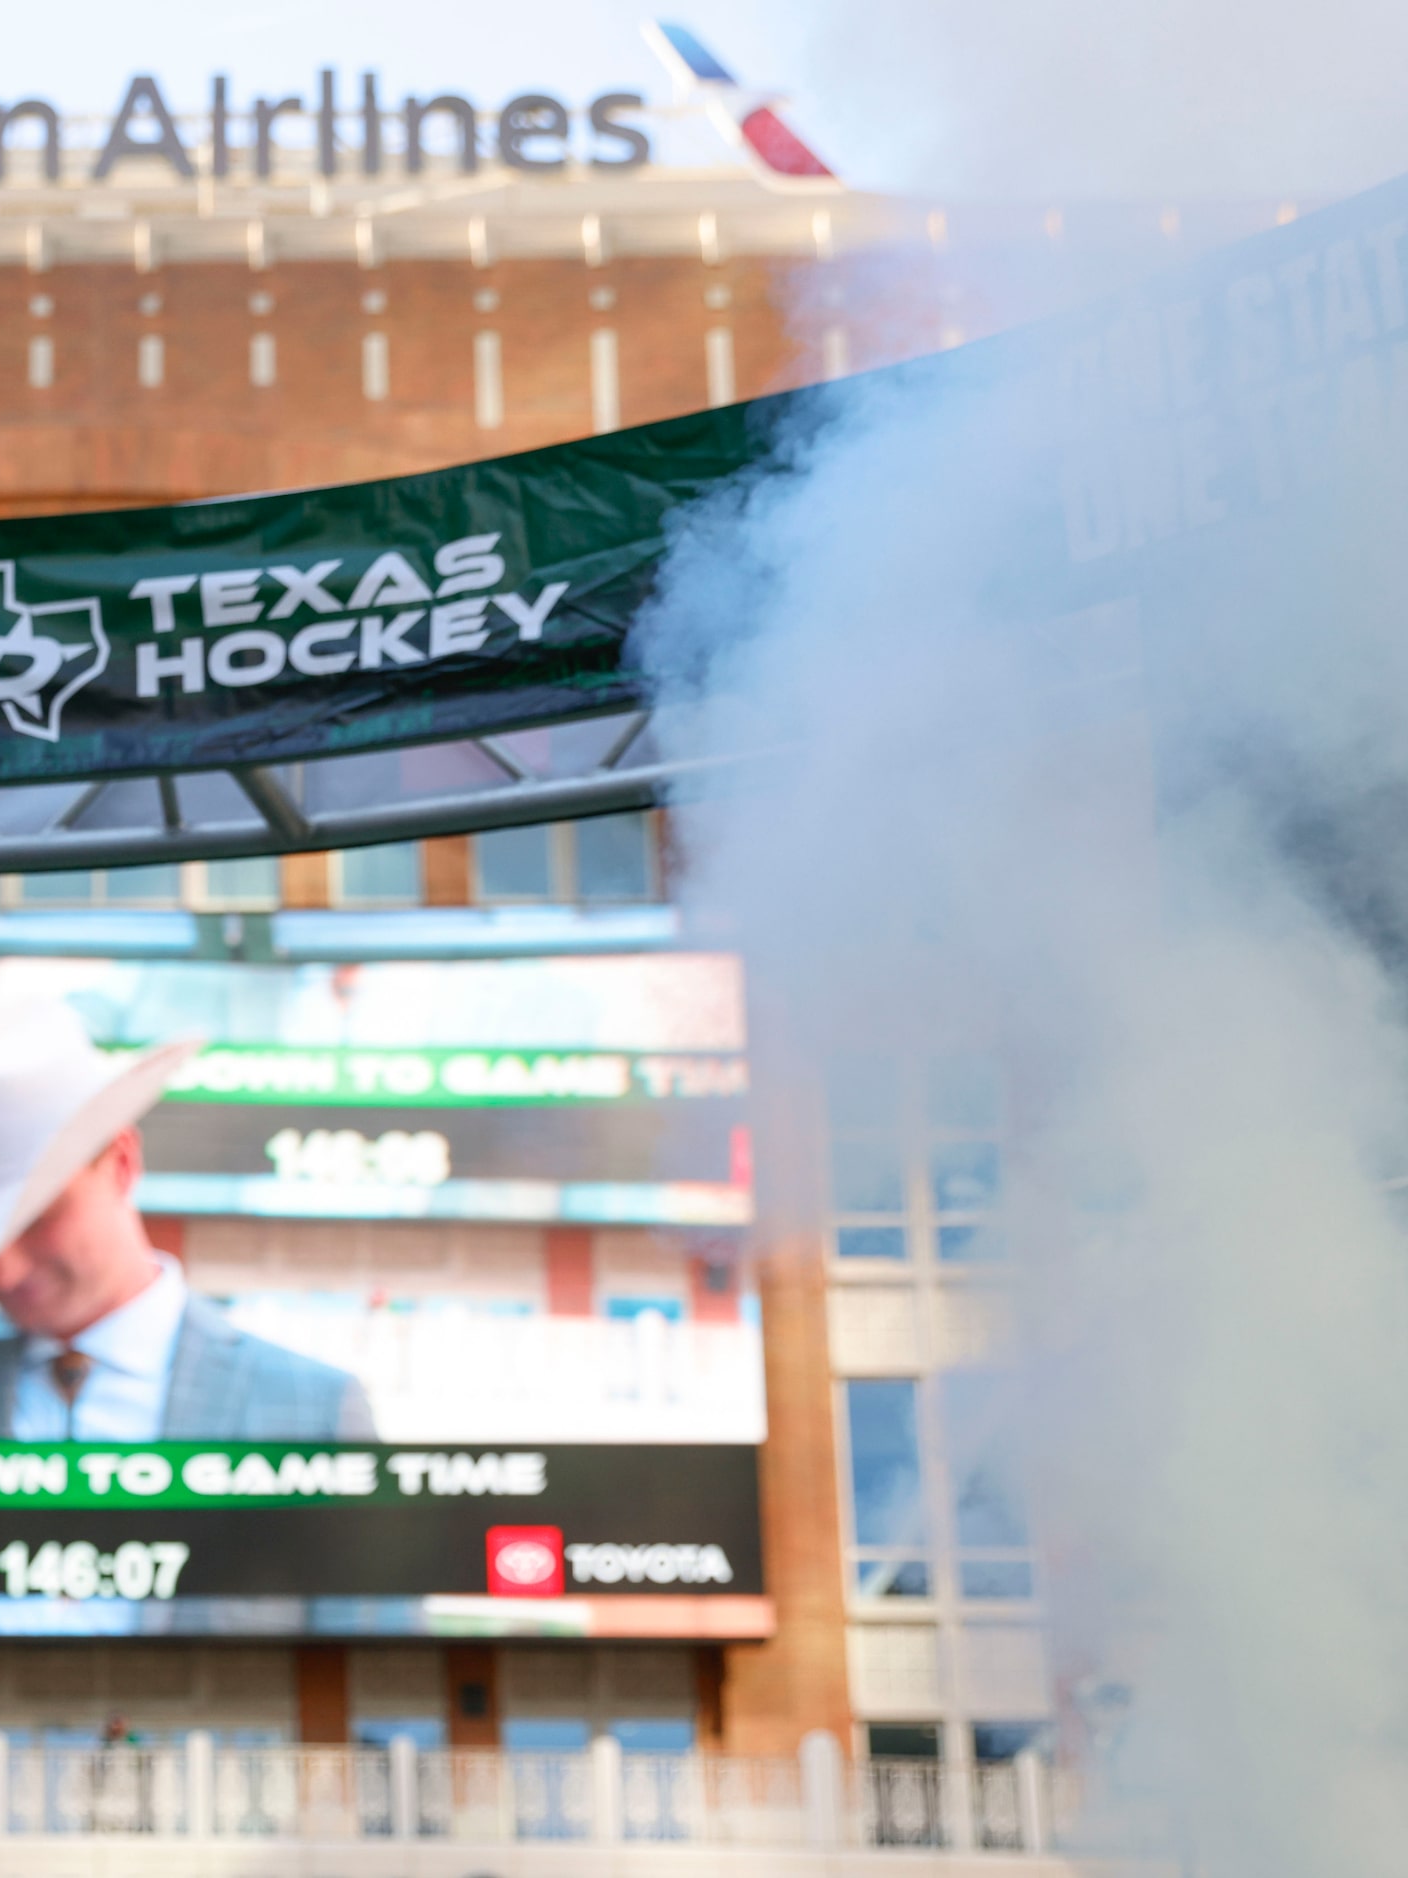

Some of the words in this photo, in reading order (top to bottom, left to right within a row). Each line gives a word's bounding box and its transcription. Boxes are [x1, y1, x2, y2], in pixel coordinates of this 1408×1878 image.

[92, 70, 649, 177] Airlines
[129, 532, 506, 634] TEXAS
[135, 582, 570, 698] HOCKEY
[345, 1054, 433, 1095] TO
[441, 1054, 631, 1096] GAME
[78, 1452, 173, 1496] TO
[182, 1452, 379, 1496] GAME
[386, 1452, 547, 1496] TIME
[564, 1543, 733, 1584] TOYOTA
